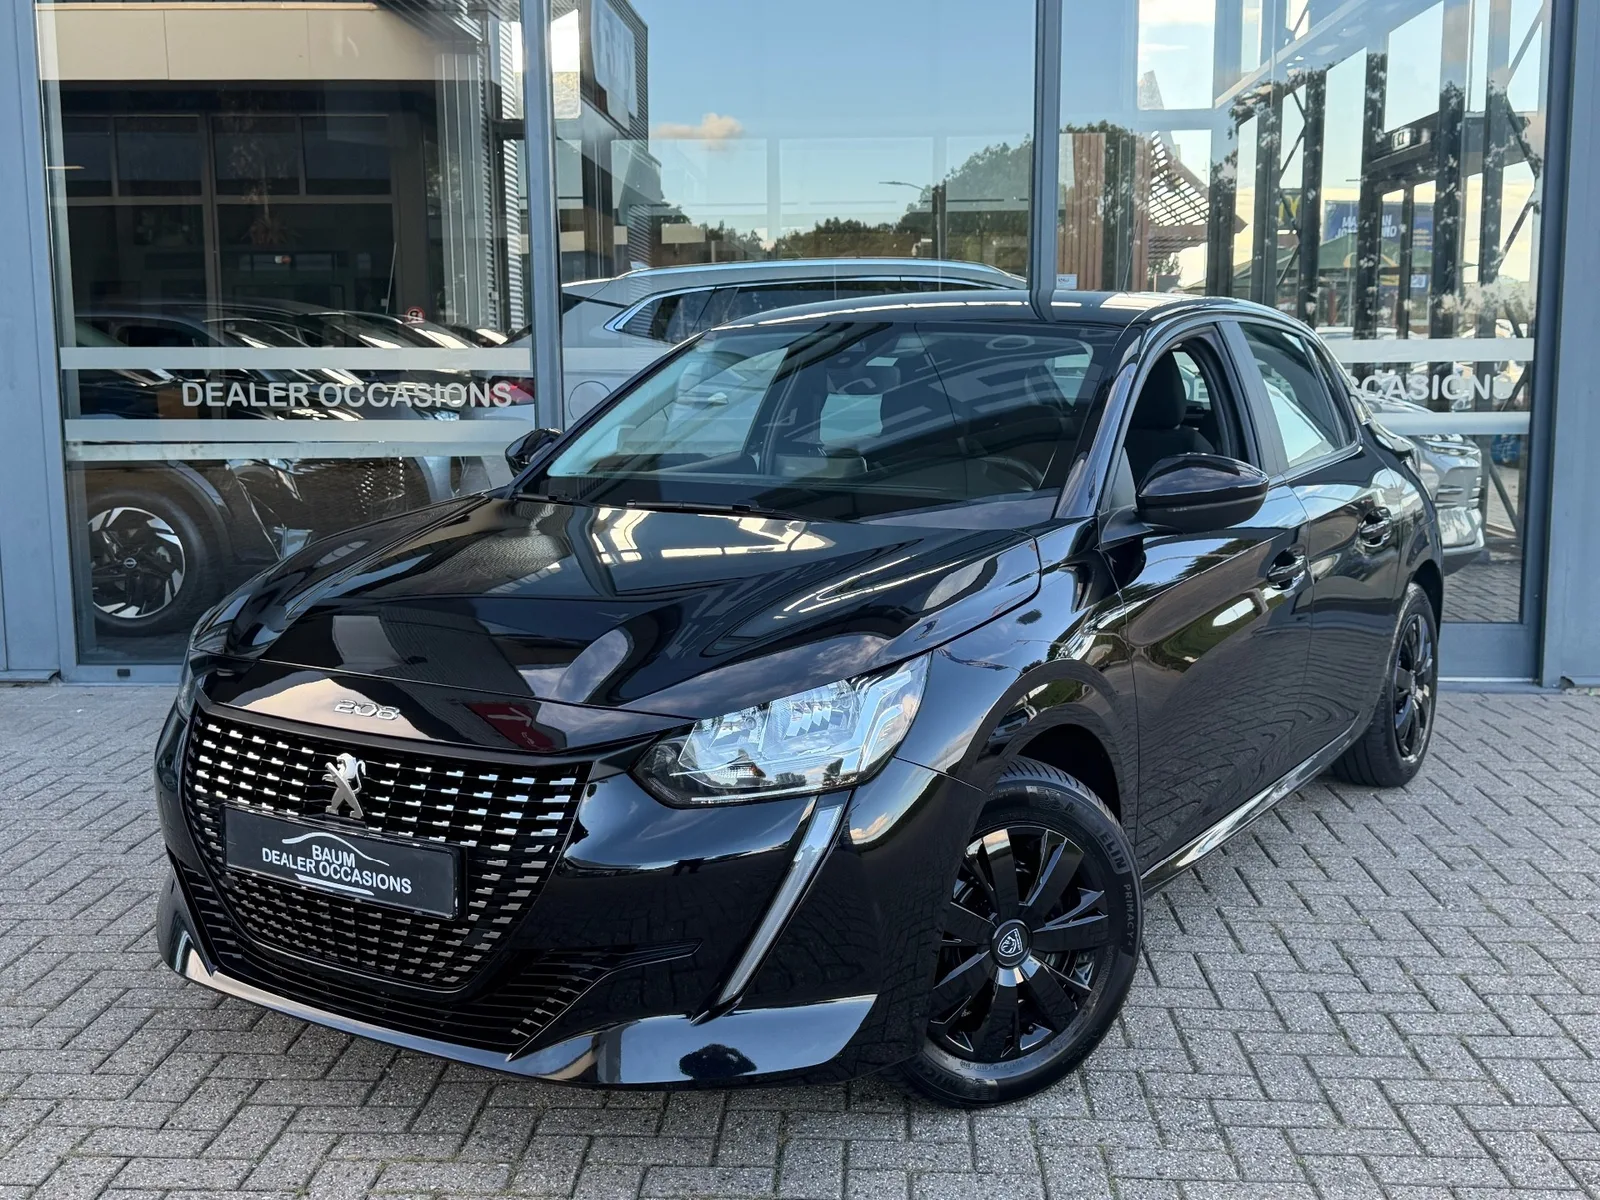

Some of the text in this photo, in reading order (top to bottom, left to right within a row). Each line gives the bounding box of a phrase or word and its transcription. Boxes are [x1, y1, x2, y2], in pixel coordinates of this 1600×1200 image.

[182, 382, 512, 407] DEALER OCCASIONS
[334, 699, 400, 720] 208
[312, 845, 356, 867] BAUM
[262, 847, 413, 894] DEALER OCCASIONS
[1123, 883, 1135, 939] PRIMACY
